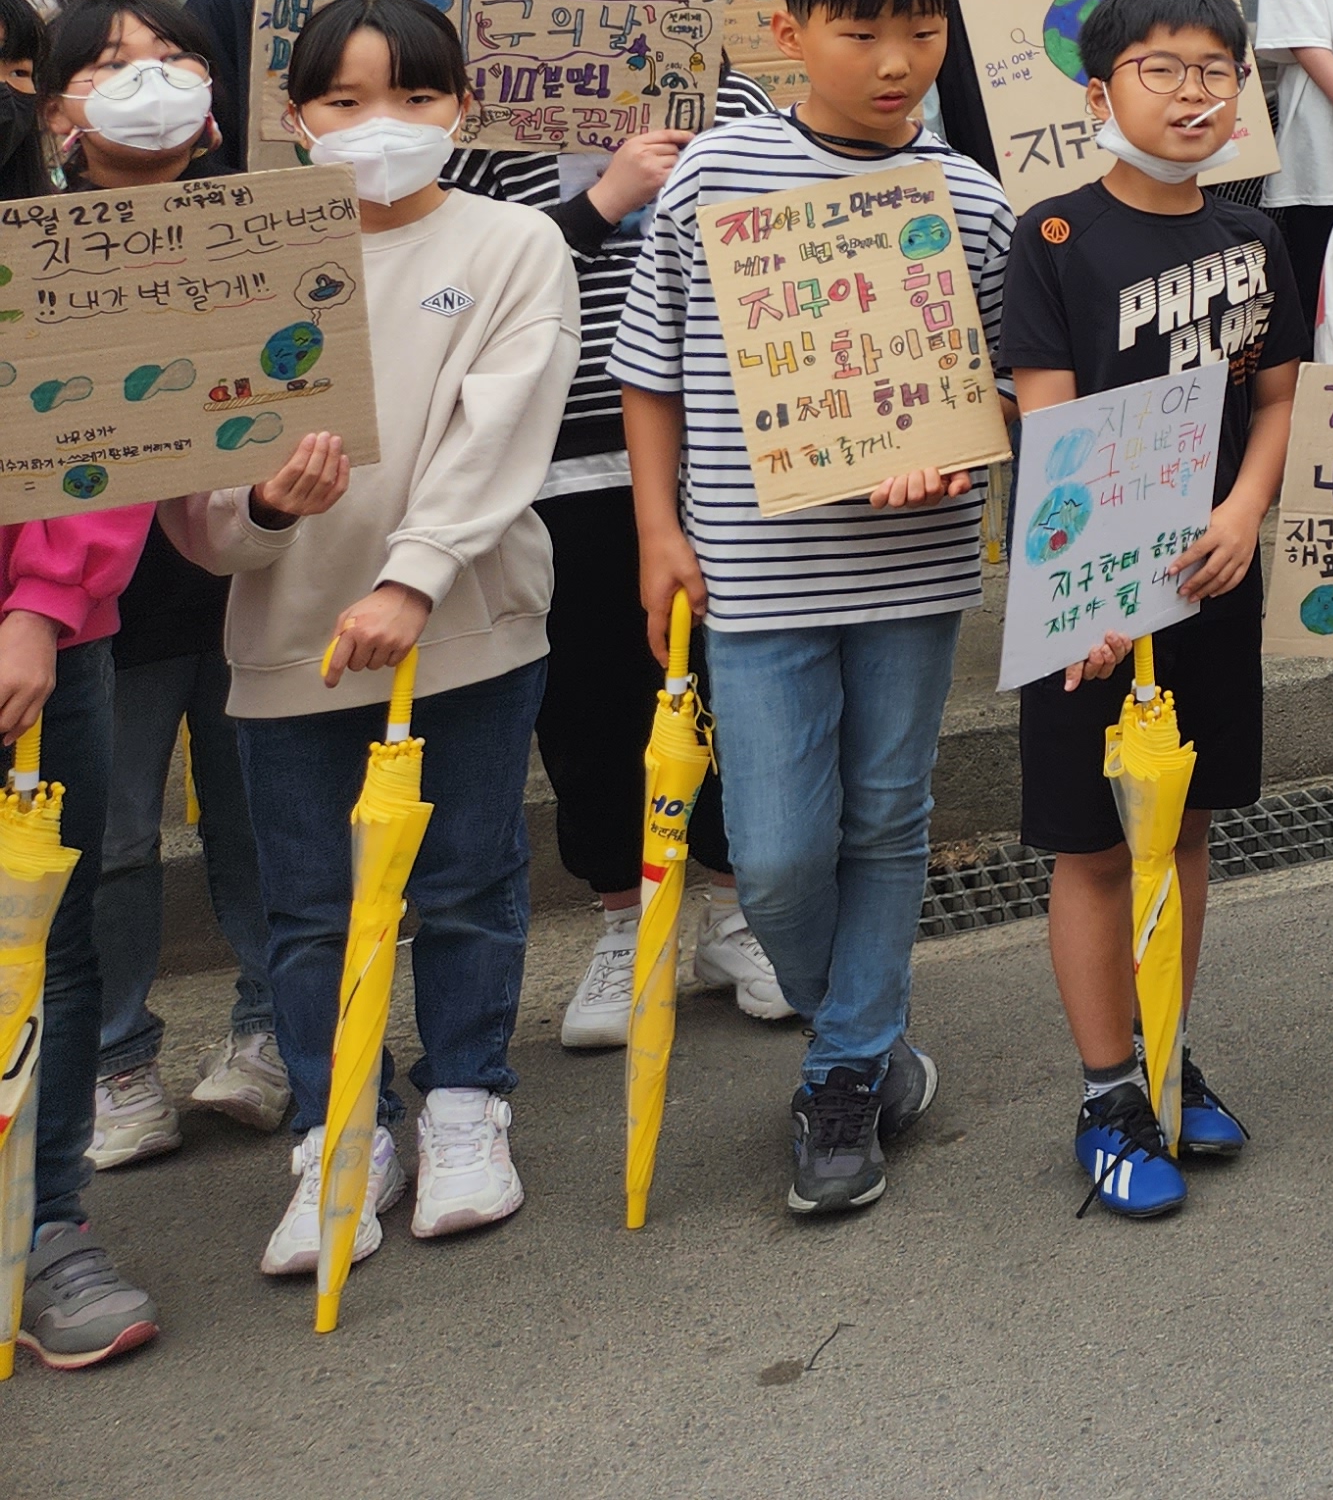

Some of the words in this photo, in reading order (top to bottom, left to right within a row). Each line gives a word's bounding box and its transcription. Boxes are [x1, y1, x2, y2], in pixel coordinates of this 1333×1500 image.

[599, 4, 642, 52] 날
[511, 105, 570, 142] 전등
[571, 103, 651, 135] 끄기!
[1, 205, 60, 236] 4월
[68, 201, 137, 228] 22일
[714, 201, 817, 246] 지구야!
[31, 223, 185, 271] 지구야!!
[737, 271, 878, 330] 지구야
[902, 263, 956, 333] 힘
[1118, 239, 1269, 351] PAPER
[736, 330, 815, 378] 내!
[830, 327, 982, 380] 화이팅!
[755, 388, 852, 432] 이제
[757, 449, 794, 476] 게
[1048, 545, 1142, 603] 지구한테
